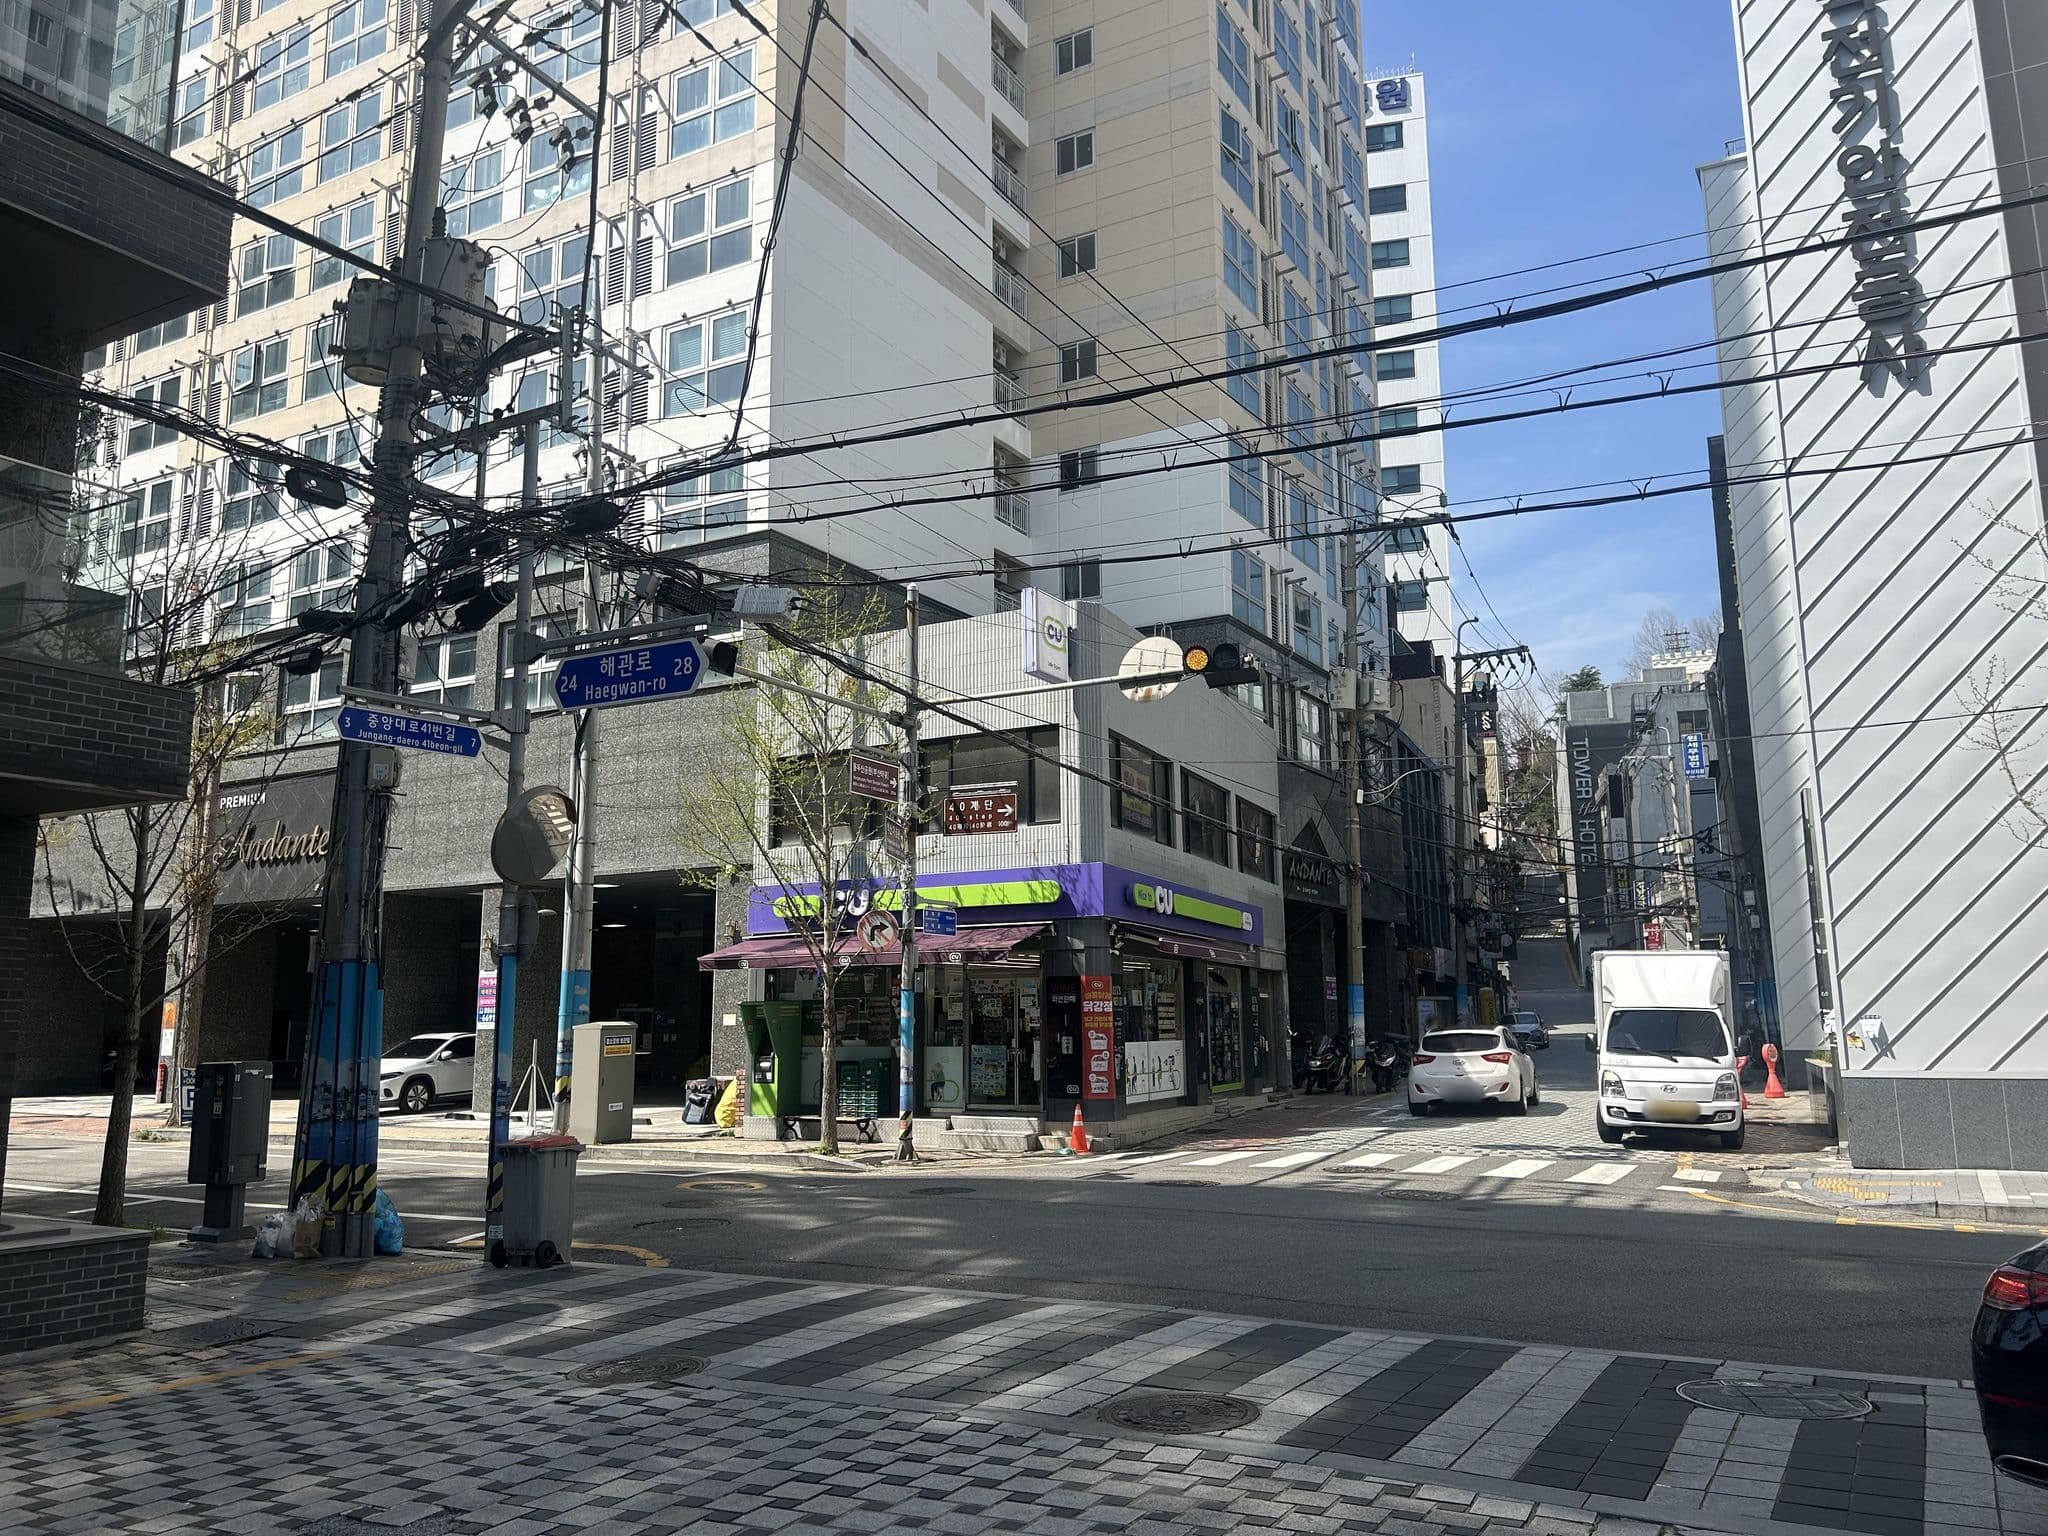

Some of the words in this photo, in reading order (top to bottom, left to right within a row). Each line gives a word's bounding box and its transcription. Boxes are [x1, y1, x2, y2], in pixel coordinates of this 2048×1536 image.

[1816, 0, 1919, 382] 전기안전공사
[599, 650, 653, 677] 해관로
[673, 656, 693, 676] 28
[560, 674, 578, 693] 24
[585, 677, 667, 701] Haegwan-ro
[344, 716, 352, 728] 3
[367, 713, 456, 742] 중앙대로41번길
[357, 729, 420, 747] Jungang-daero
[421, 739, 463, 755] 41beon-gil
[471, 737, 477, 748] 7
[1572, 737, 1593, 799] TOWER
[220, 791, 266, 809] PREMIUM
[213, 820, 330, 864] Andante
[1579, 819, 1599, 873] HOTEL
[824, 888, 869, 917] CU
[1155, 885, 1173, 915] CU
[1083, 1000, 1112, 1012] 닭강정
